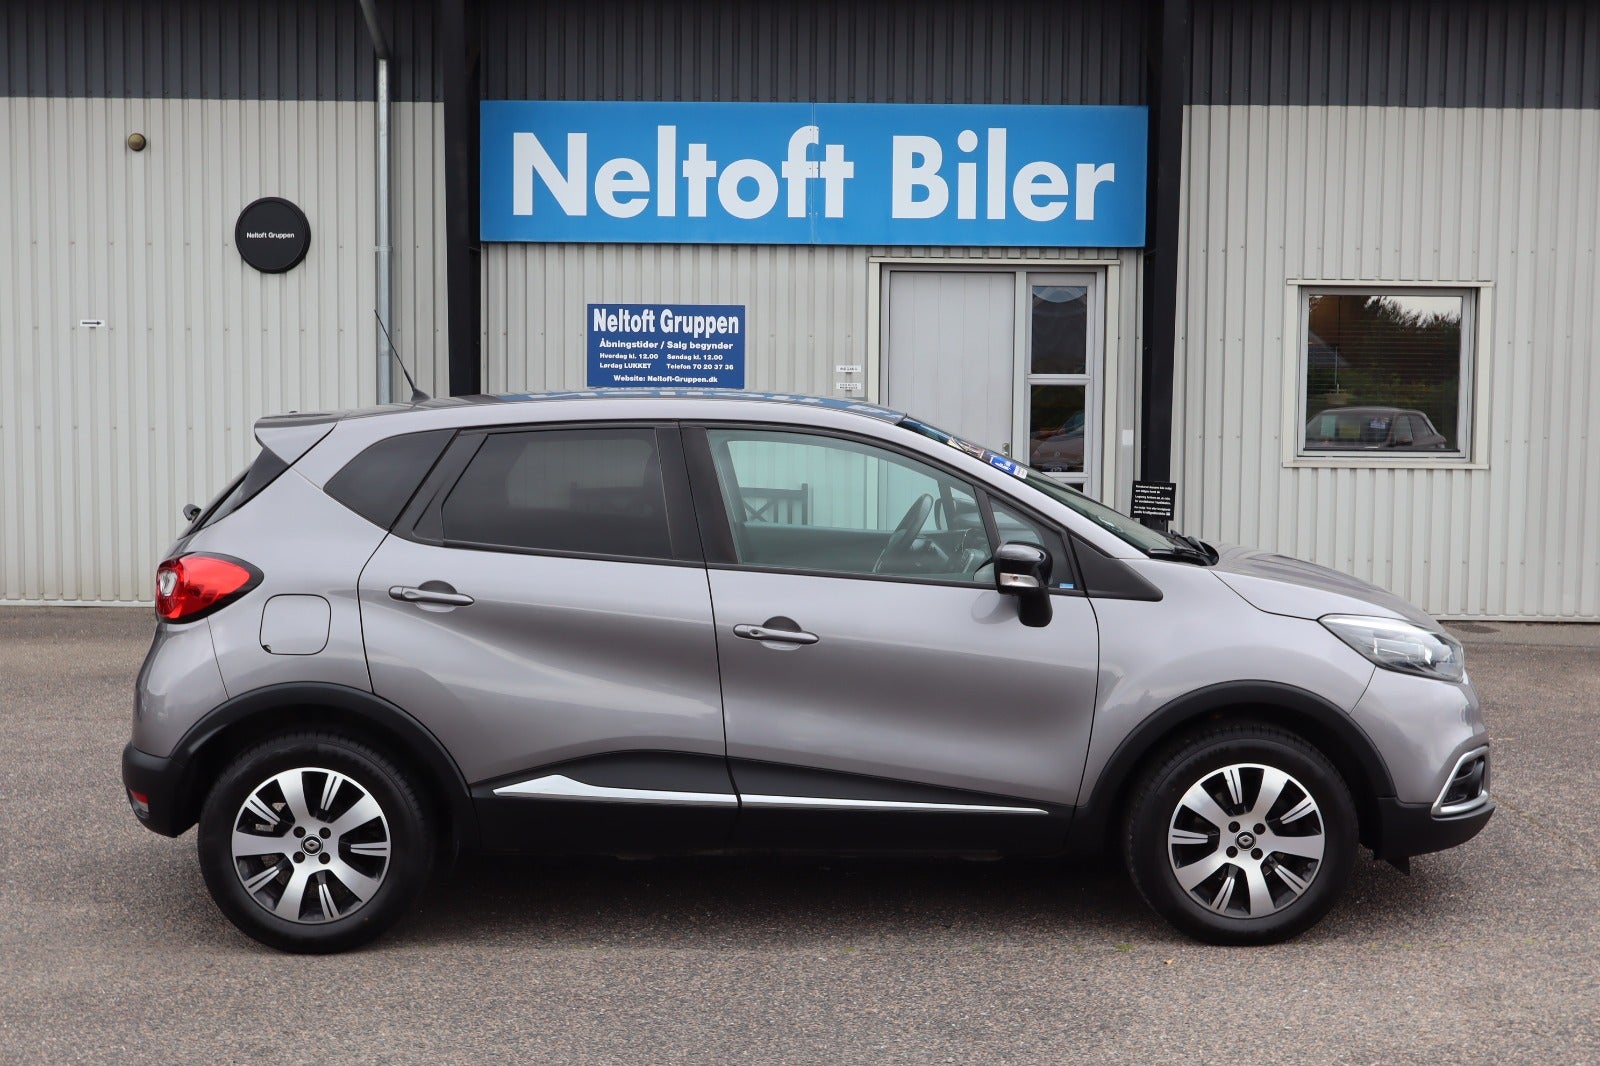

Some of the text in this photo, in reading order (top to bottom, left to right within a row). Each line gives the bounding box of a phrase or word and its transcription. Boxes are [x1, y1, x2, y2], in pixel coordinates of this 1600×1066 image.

[512, 124, 1116, 222] Neltoft Biler
[593, 308, 739, 338] Neltoft Gruppen
[599, 338, 659, 349] Åbningstider
[666, 341, 687, 350] Salg
[689, 341, 734, 351] begynder
[599, 352, 628, 360] Hverdag
[599, 362, 623, 370] Lørdag
[613, 374, 718, 384] Website: Neltoft-Gruppen.dk
